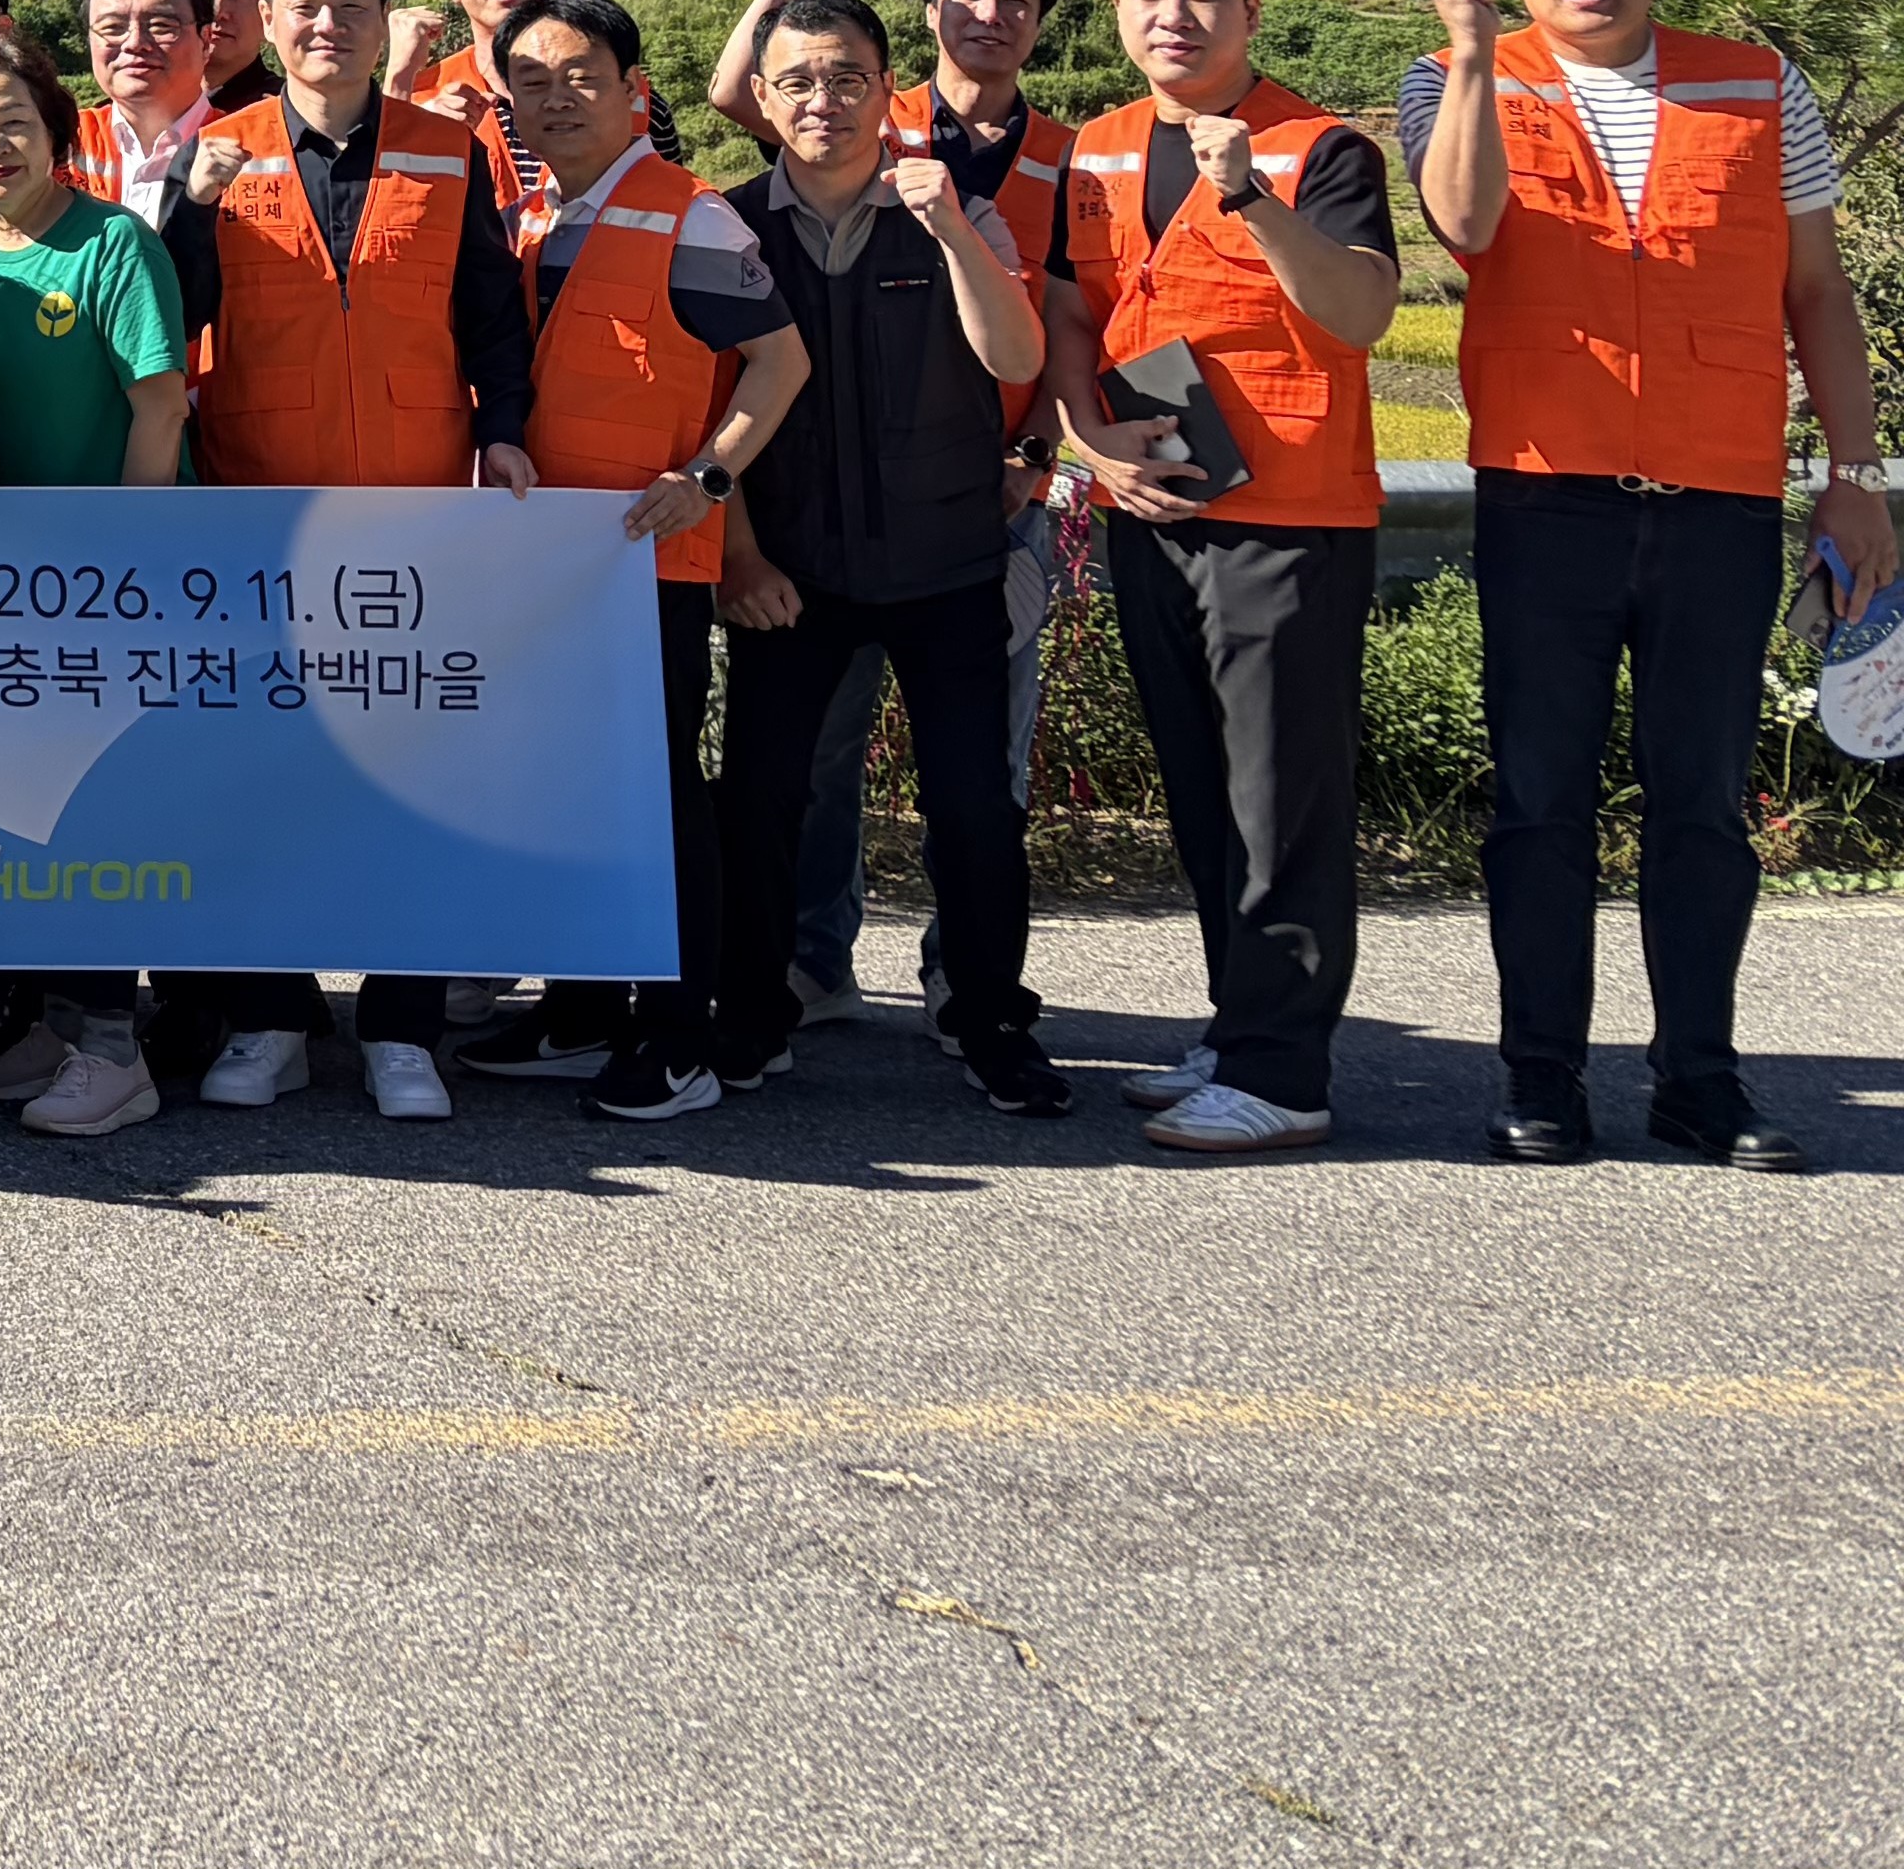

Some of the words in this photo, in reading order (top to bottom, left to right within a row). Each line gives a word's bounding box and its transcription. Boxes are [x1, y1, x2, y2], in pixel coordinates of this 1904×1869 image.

[1504, 99, 1549, 117] 전사
[1508, 120, 1553, 140] 의체
[232, 180, 281, 199] 전사
[181, 567, 229, 622] 9.
[247, 569, 314, 623] 11.
[333, 564, 424, 631] (금)
[127, 647, 238, 710] 진천
[259, 648, 486, 711] 상백마을
